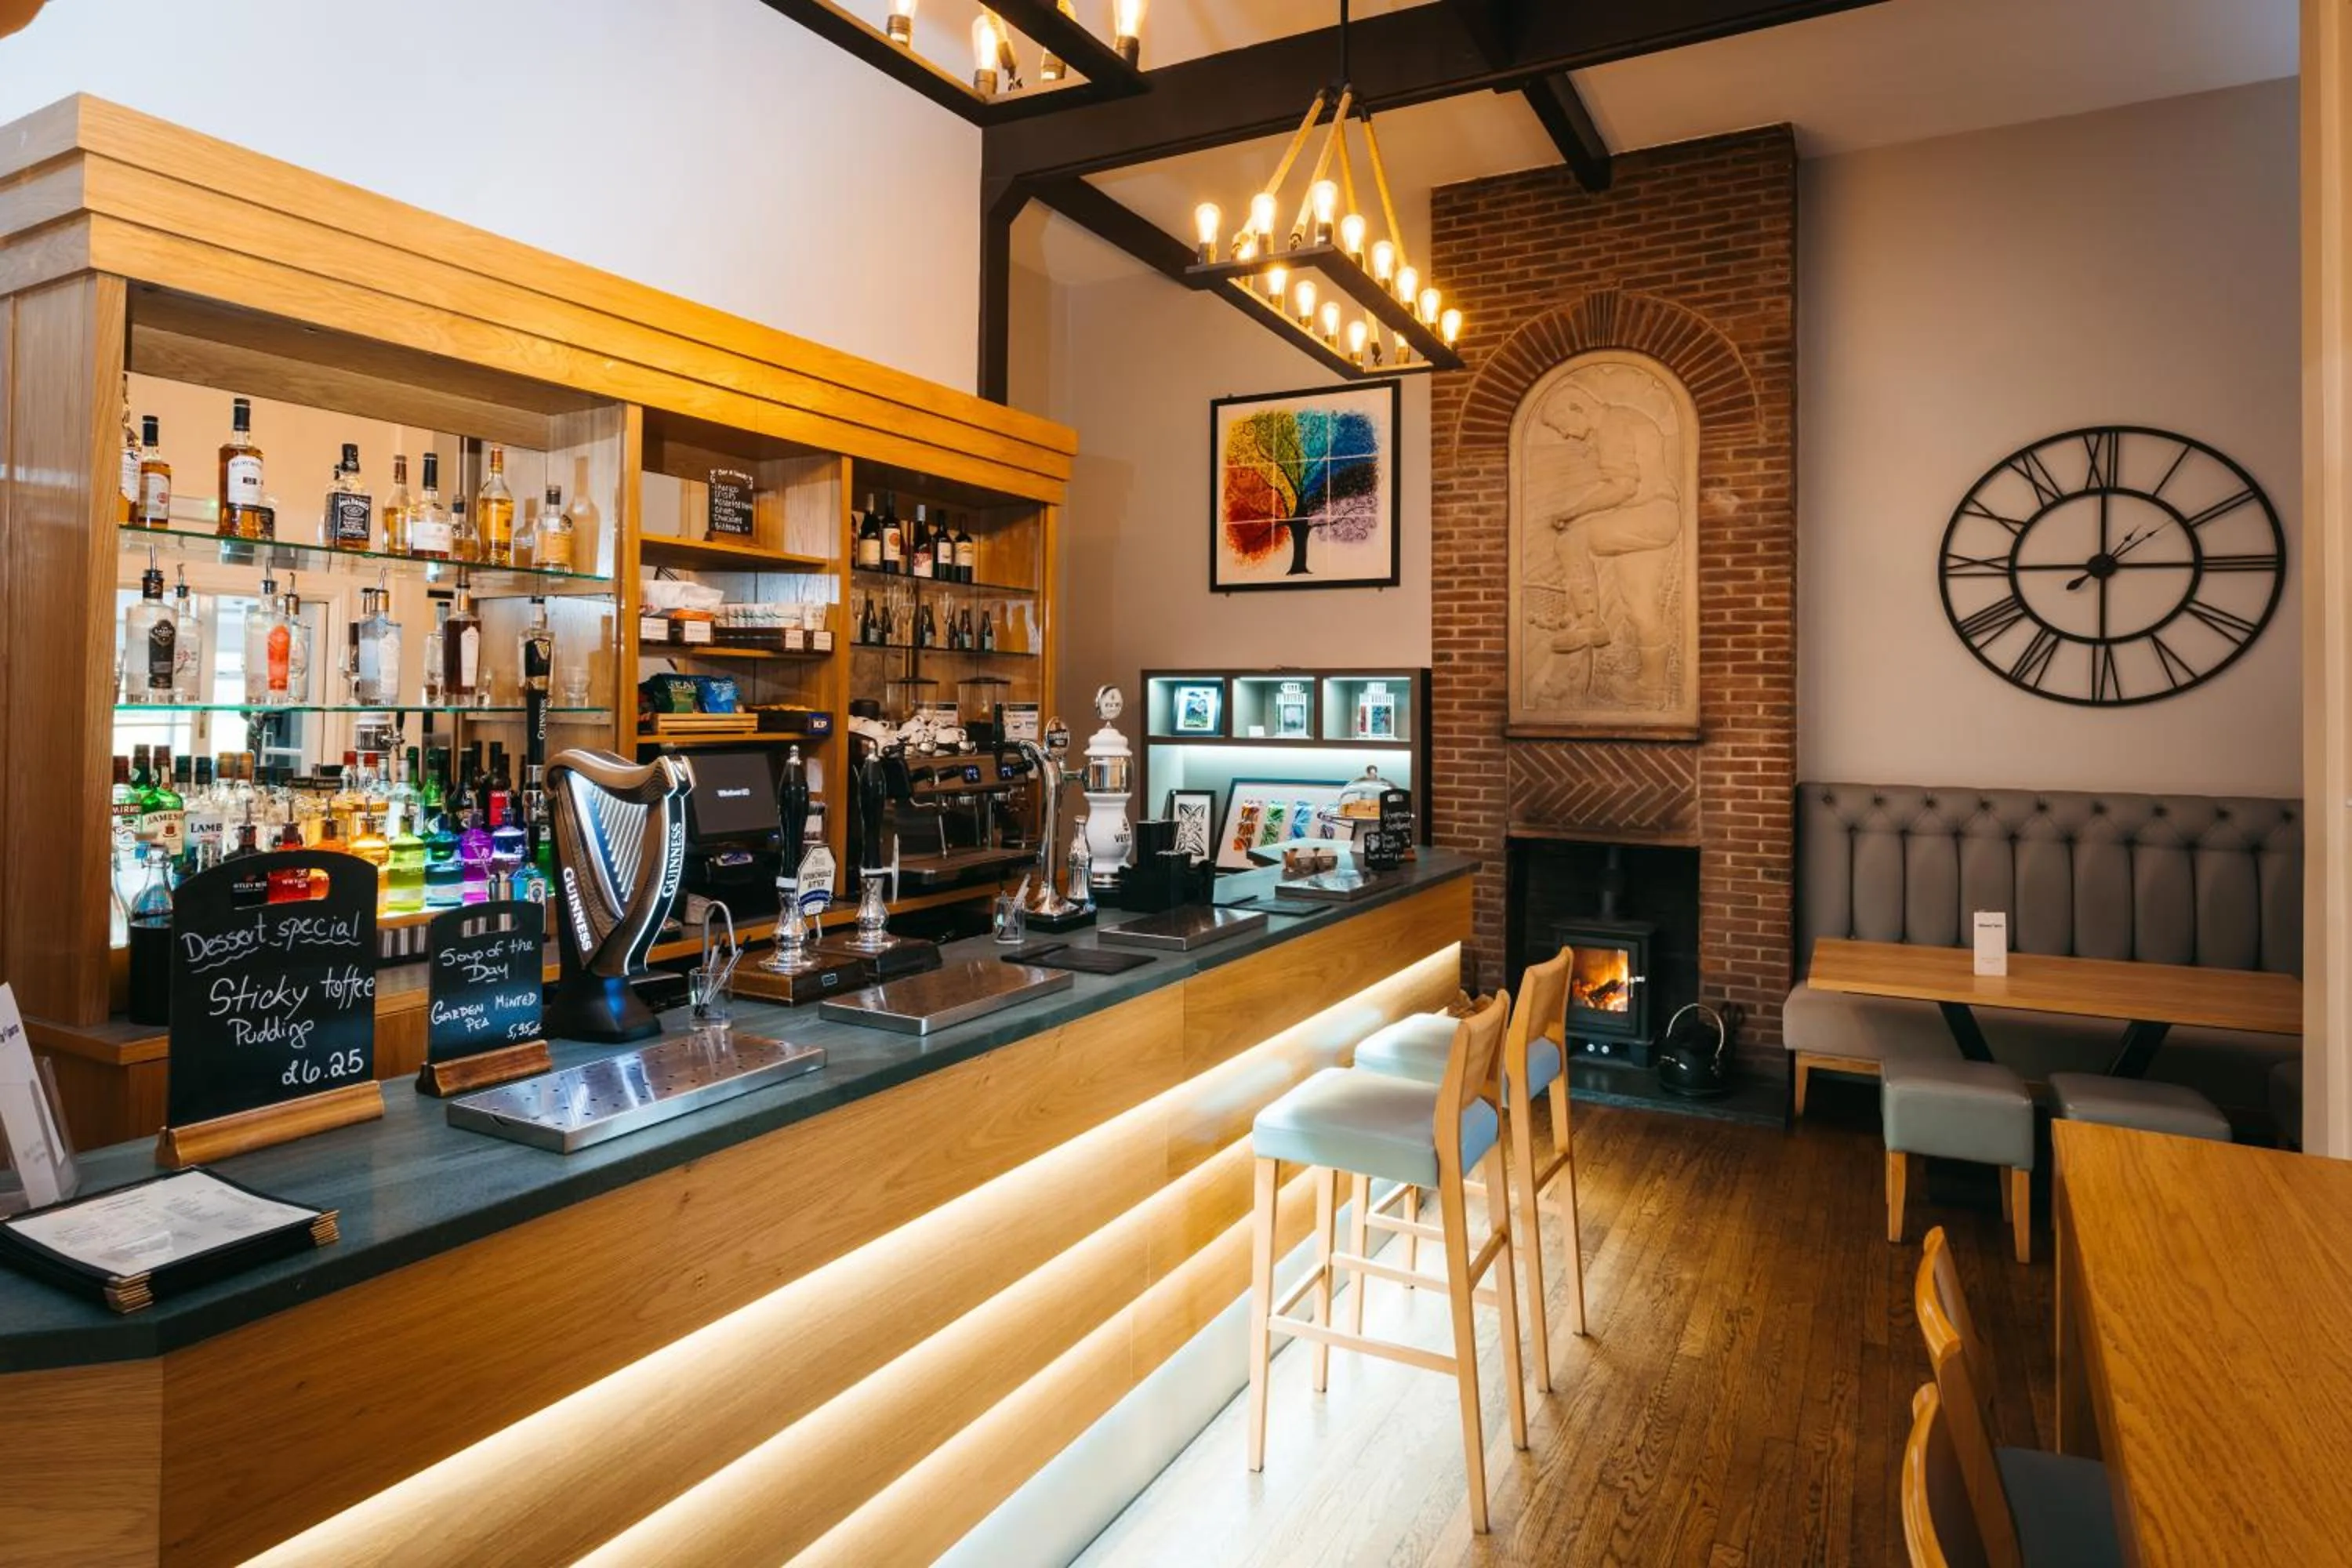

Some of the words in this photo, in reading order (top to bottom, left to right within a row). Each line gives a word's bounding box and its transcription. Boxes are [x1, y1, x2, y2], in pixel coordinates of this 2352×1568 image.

[191, 823, 223, 833] LAMB
[662, 822, 681, 898] GUINNESS
[563, 866, 593, 952] GUINNESS
[181, 913, 267, 962] Dessert
[277, 910, 360, 951] special
[439, 948, 484, 967] Soup
[486, 940, 504, 957] of
[509, 938, 535, 953] the
[462, 963, 509, 982] Day
[209, 975, 309, 1020] Sticky
[320, 964, 375, 1010] toffee
[464, 1017, 490, 1033] PEA
[281, 1048, 365, 1085] £6.25
